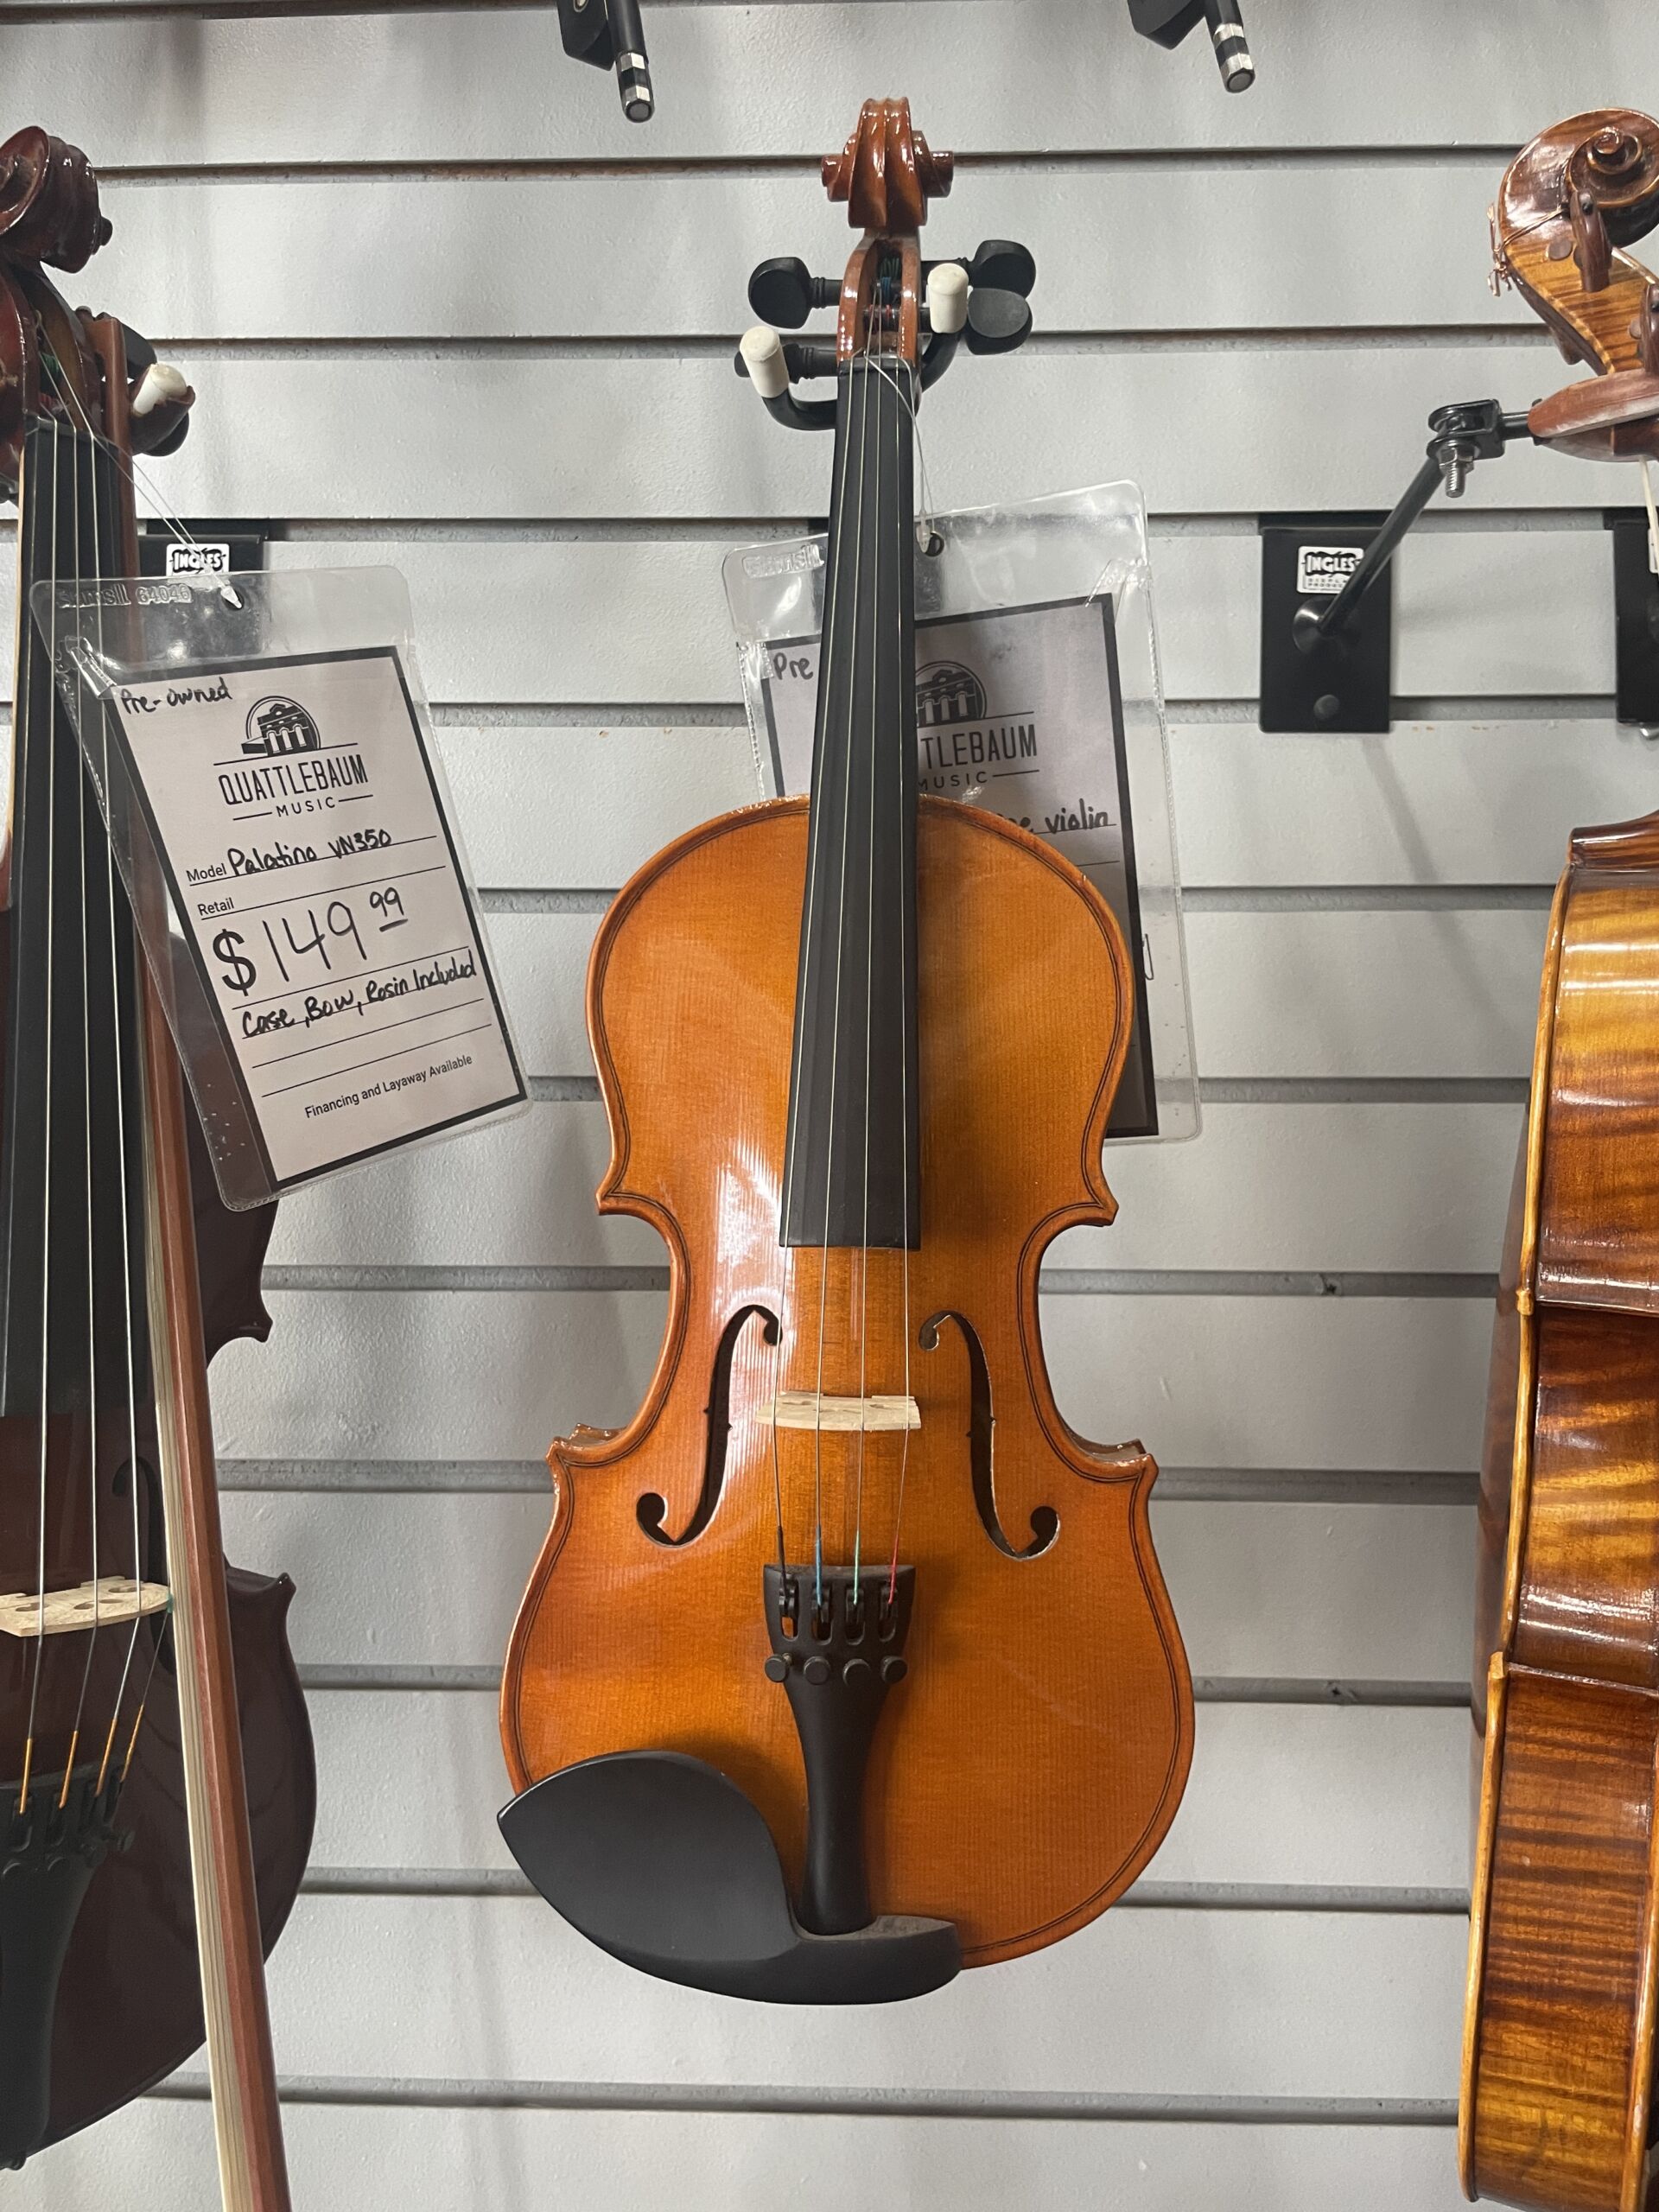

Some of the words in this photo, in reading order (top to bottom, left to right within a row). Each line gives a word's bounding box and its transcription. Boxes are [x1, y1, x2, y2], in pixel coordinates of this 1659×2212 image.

[1306, 555, 1356, 572] INGLES
[120, 676, 233, 715] Pre-owned
[920, 724, 1038, 769] TLEBAUM
[218, 753, 369, 805] QUATTLEBAUM
[276, 796, 335, 817] MUSIC
[1045, 798, 1109, 835] violin
[186, 862, 228, 882] Model
[227, 842, 318, 877] Palatino
[327, 829, 392, 859] VN350
[197, 897, 235, 916] Retail
[412, 948, 477, 990] Included
[304, 1093, 360, 1119] Financing
[361, 1083, 382, 1100] and
[382, 1070, 428, 1093] Layaway
[429, 1054, 474, 1078] Available
